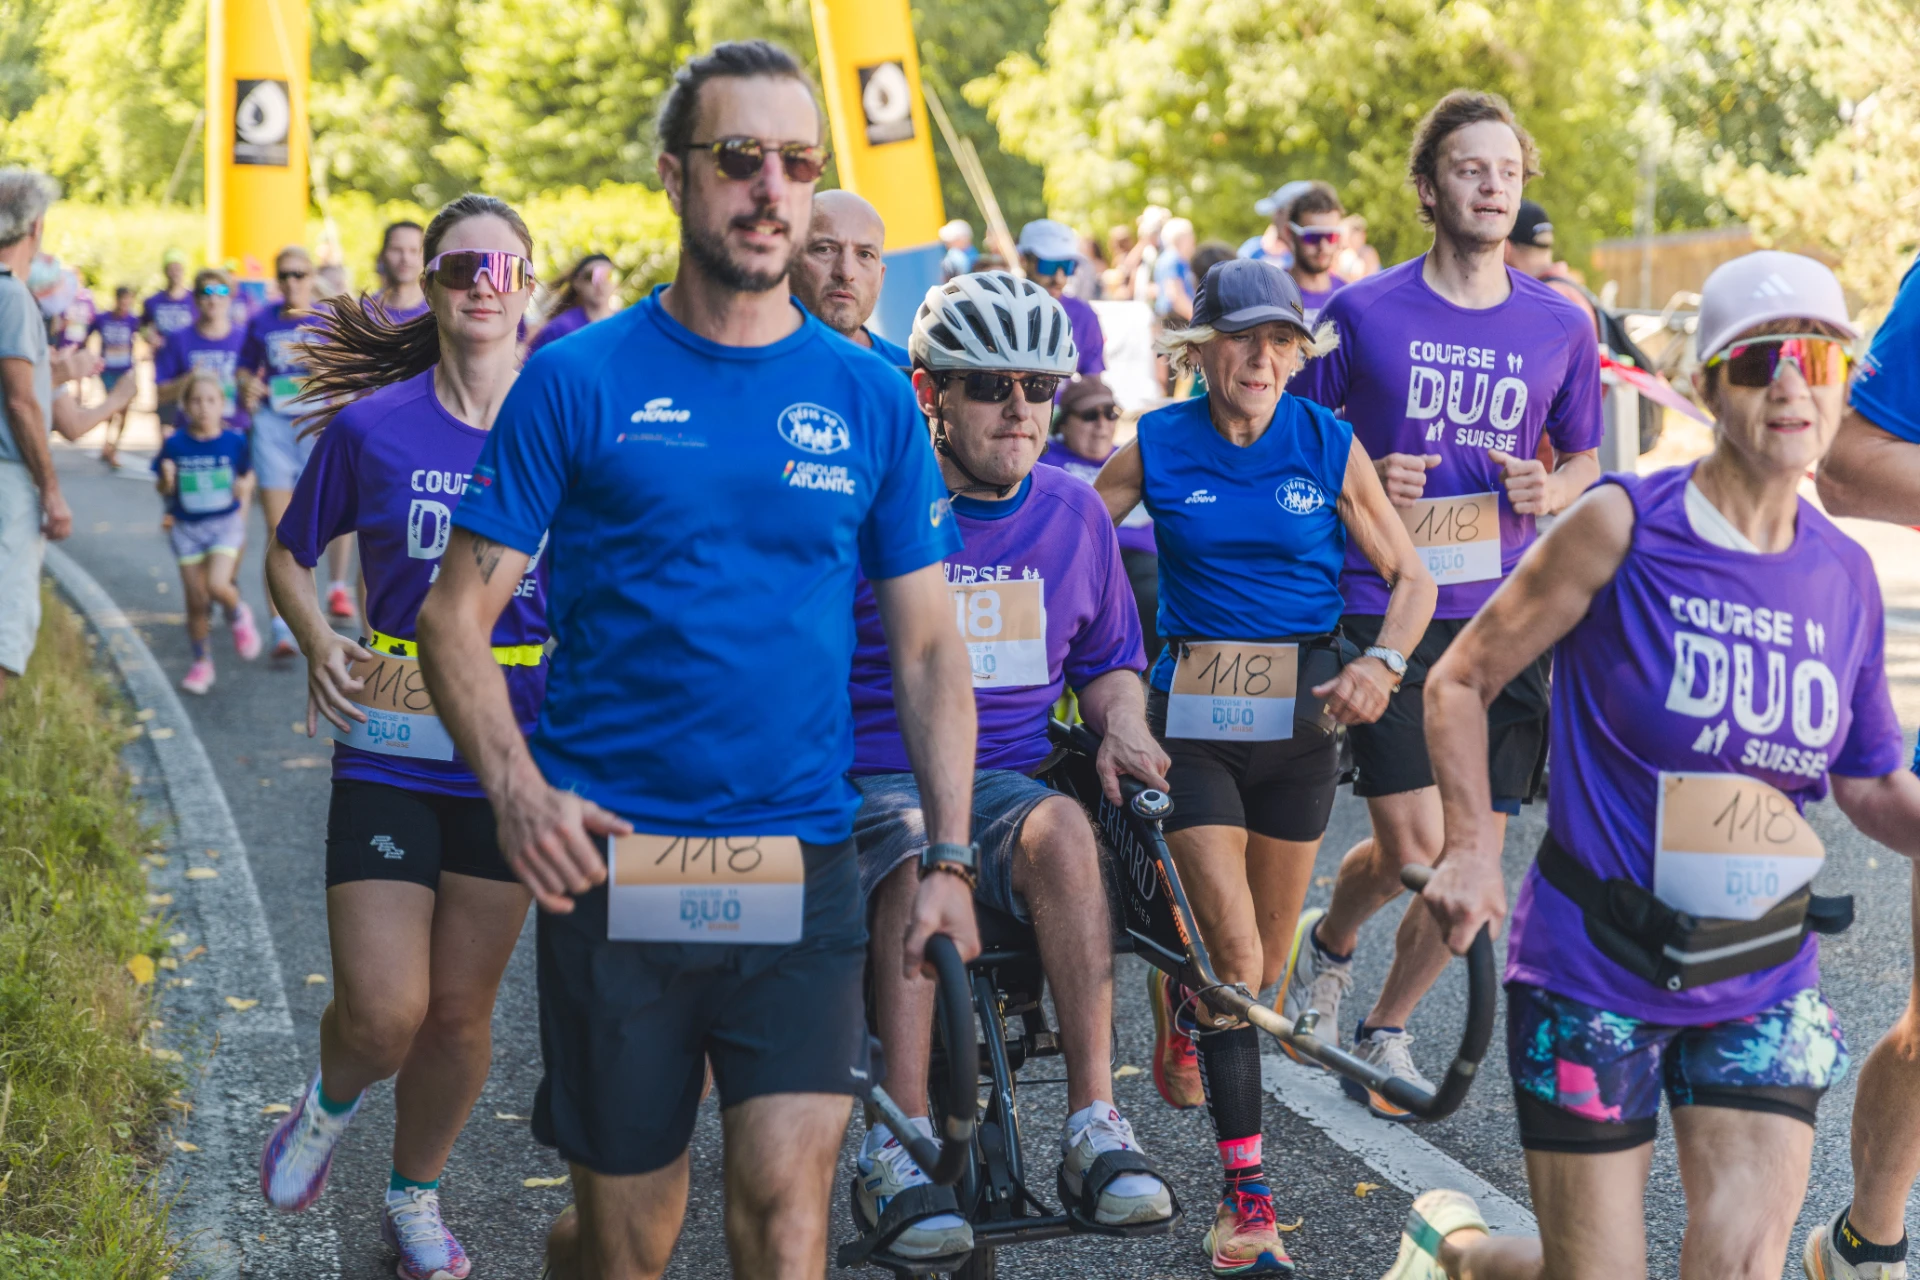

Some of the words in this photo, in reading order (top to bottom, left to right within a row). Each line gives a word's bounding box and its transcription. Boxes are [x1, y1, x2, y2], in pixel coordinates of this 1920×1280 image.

[1409, 340, 1496, 370] COURSE
[1405, 365, 1528, 431] DUO
[1455, 428, 1518, 452] SUISSE
[410, 469, 473, 496] COU
[789, 472, 856, 495] ATLANTIC
[796, 461, 847, 479] GROUPE
[1415, 503, 1480, 542] 118
[944, 562, 1011, 585] URSE
[1429, 553, 1464, 571] DUO
[954, 589, 1002, 638] 18
[1669, 594, 1794, 647] COURSE
[972, 653, 996, 673] UO
[1198, 652, 1271, 695] 118
[364, 661, 432, 711] 118
[1664, 630, 1839, 748] DUO
[368, 710, 399, 721] COURSE
[1212, 707, 1254, 726] DUO
[367, 719, 411, 741] DUO
[1740, 738, 1829, 780] SUISSE
[1713, 789, 1796, 843] 118
[655, 836, 762, 873] 118
[1725, 871, 1779, 896] DUO
[680, 899, 741, 921] DUO
